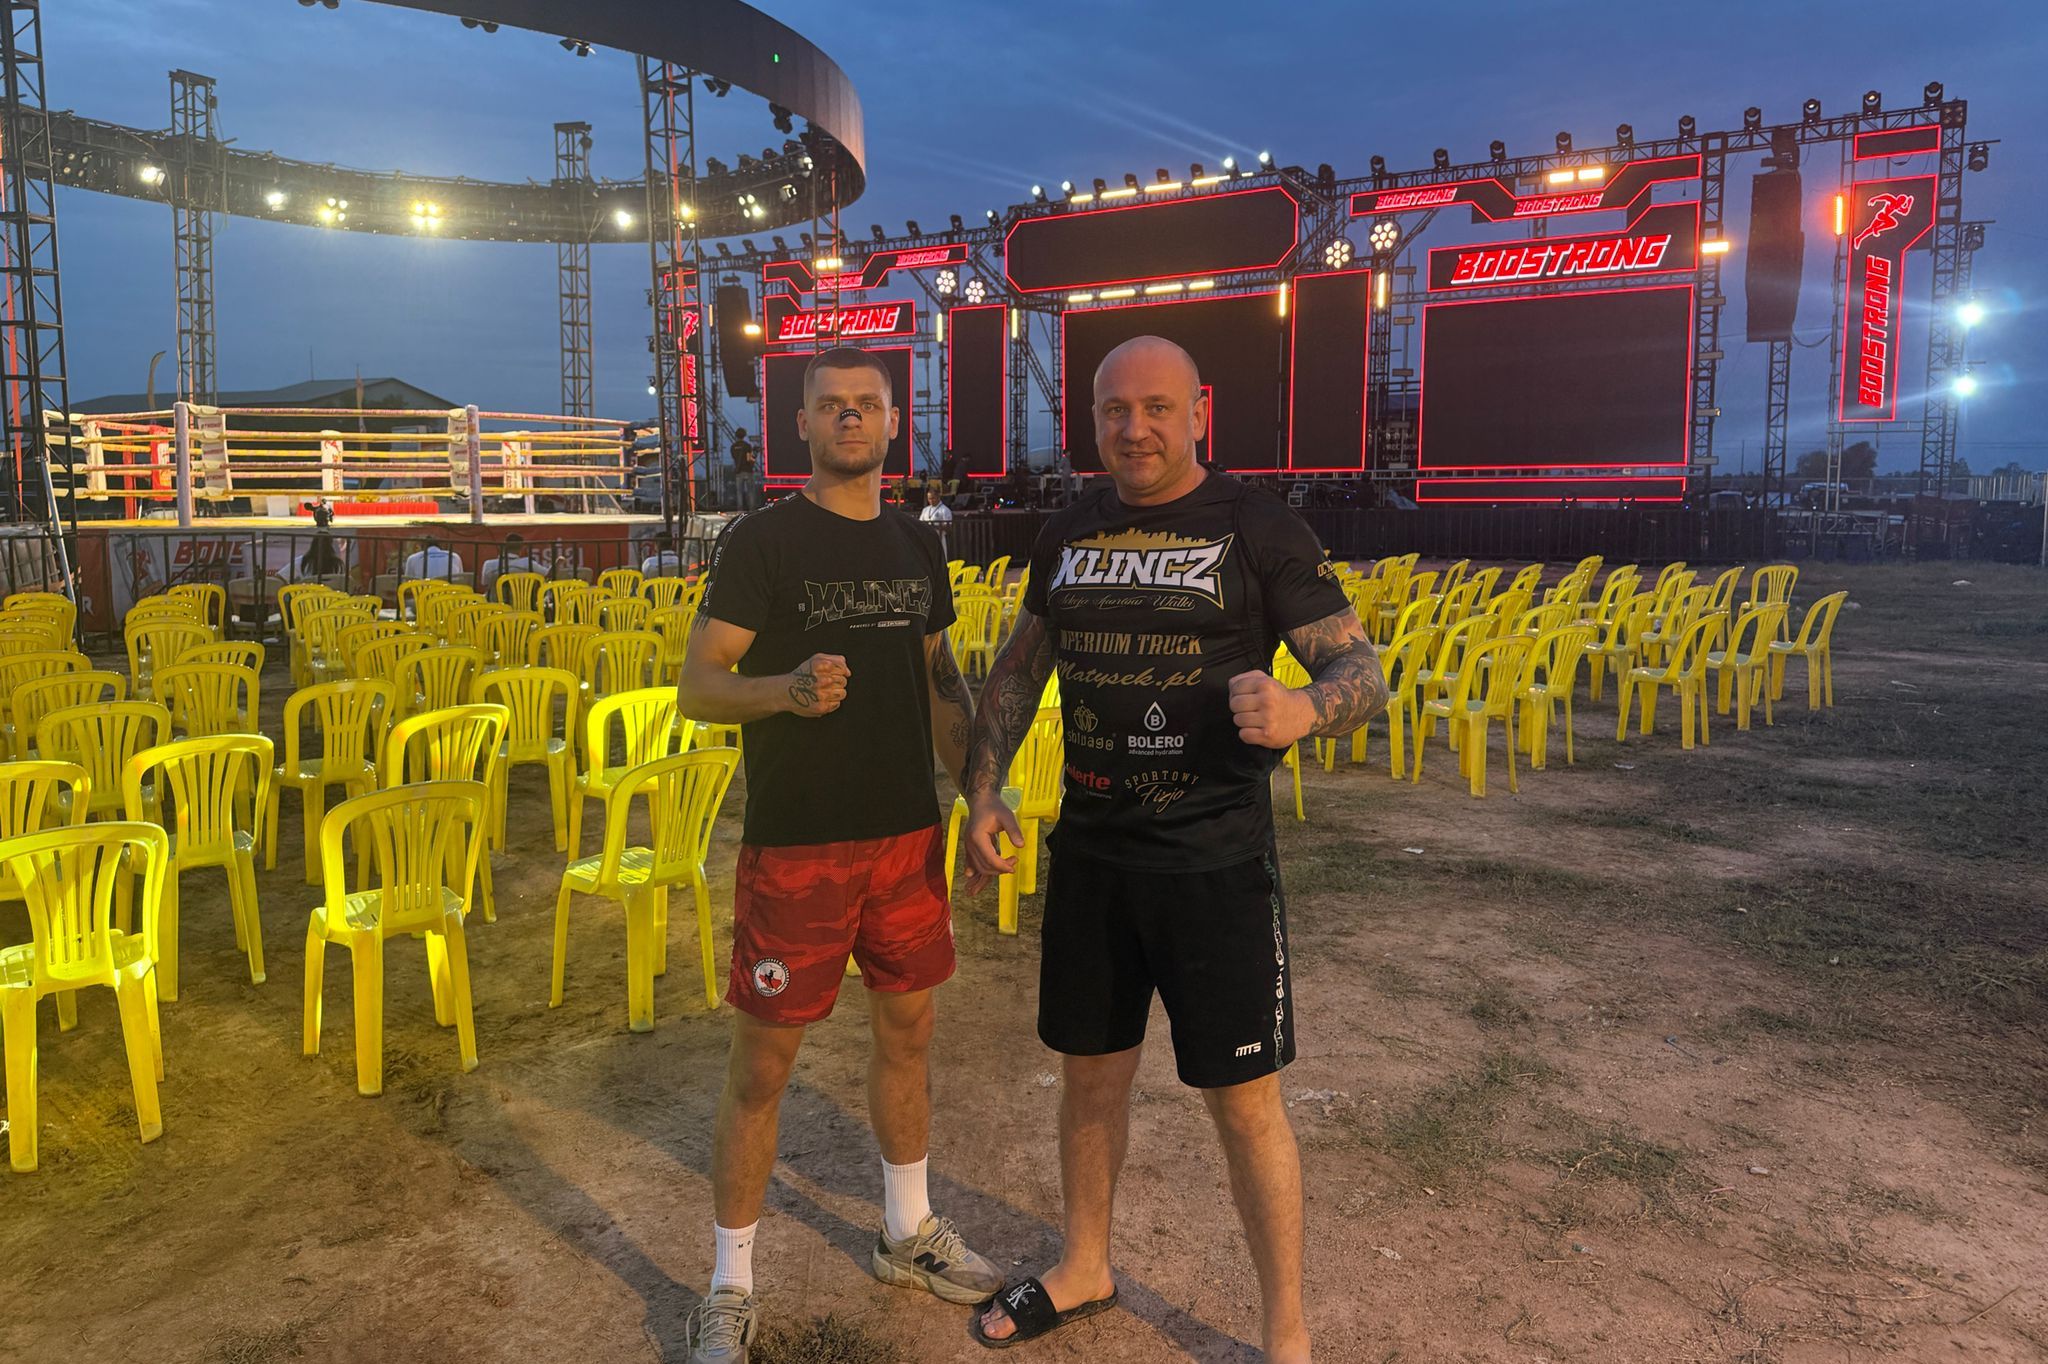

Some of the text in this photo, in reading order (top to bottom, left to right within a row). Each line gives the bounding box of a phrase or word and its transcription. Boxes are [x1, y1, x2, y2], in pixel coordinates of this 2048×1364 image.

[1374, 187, 1458, 210] BOOSTRONG
[1513, 193, 1604, 216] BOOSTRONG
[1451, 234, 1671, 284] BOOSTRONG
[1858, 254, 1892, 409] BOOSTRONG
[1050, 540, 1228, 597] KLINCZ
[804, 575, 932, 632] KLINCZ
[1060, 628, 1203, 655] MPERIUM TRUCK
[1128, 735, 1184, 749] BOLERO
[1125, 770, 1199, 789] SPORTOWY
